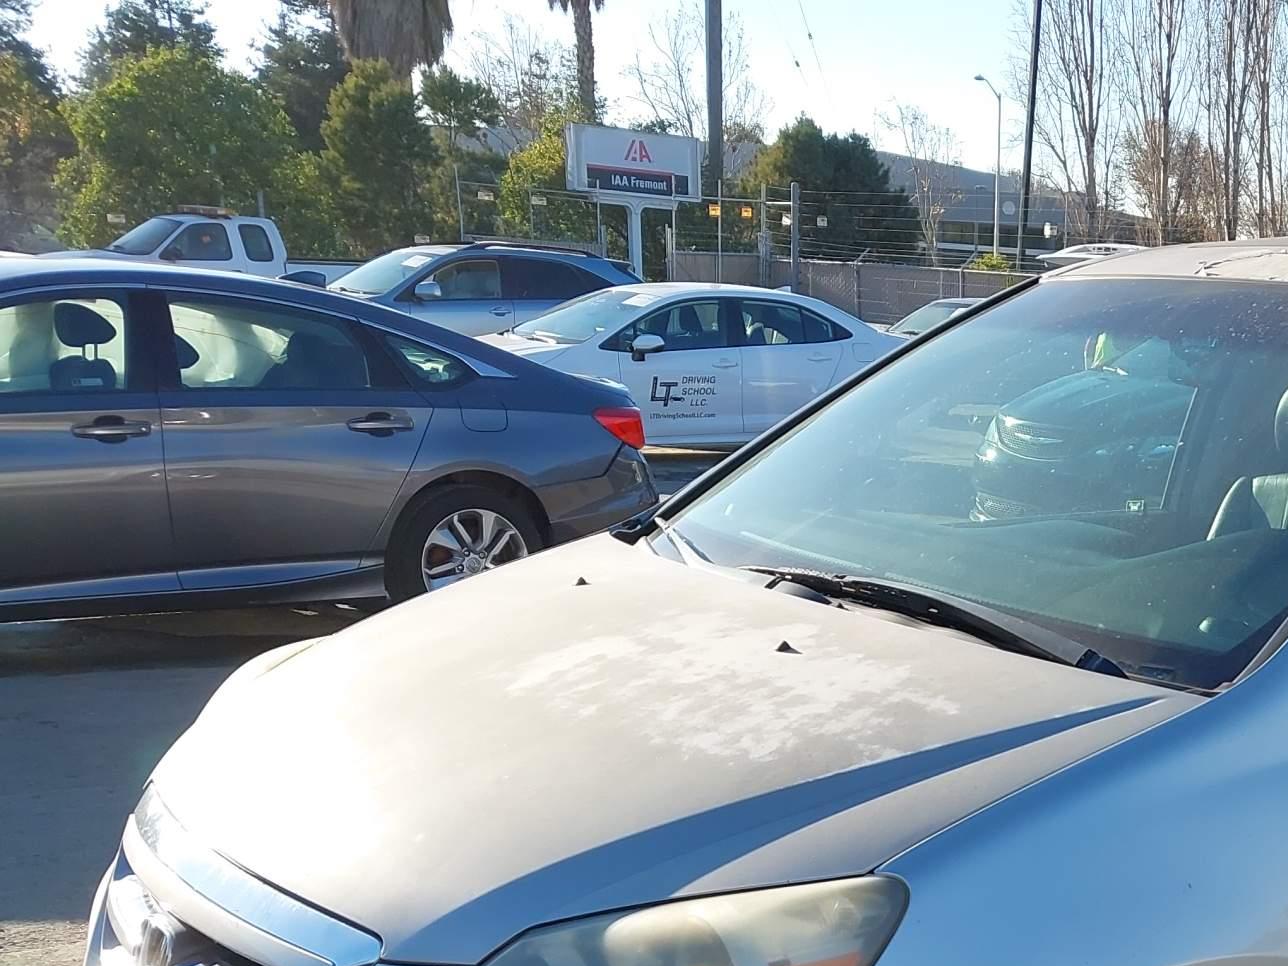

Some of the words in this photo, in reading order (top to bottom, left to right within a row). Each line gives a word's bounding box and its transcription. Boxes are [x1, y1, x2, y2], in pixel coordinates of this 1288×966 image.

[611, 174, 629, 187] IAA
[630, 176, 667, 191] Fremont
[682, 376, 716, 385] DRIVING
[650, 376, 678, 407] LT
[681, 387, 717, 396] SCHOOL
